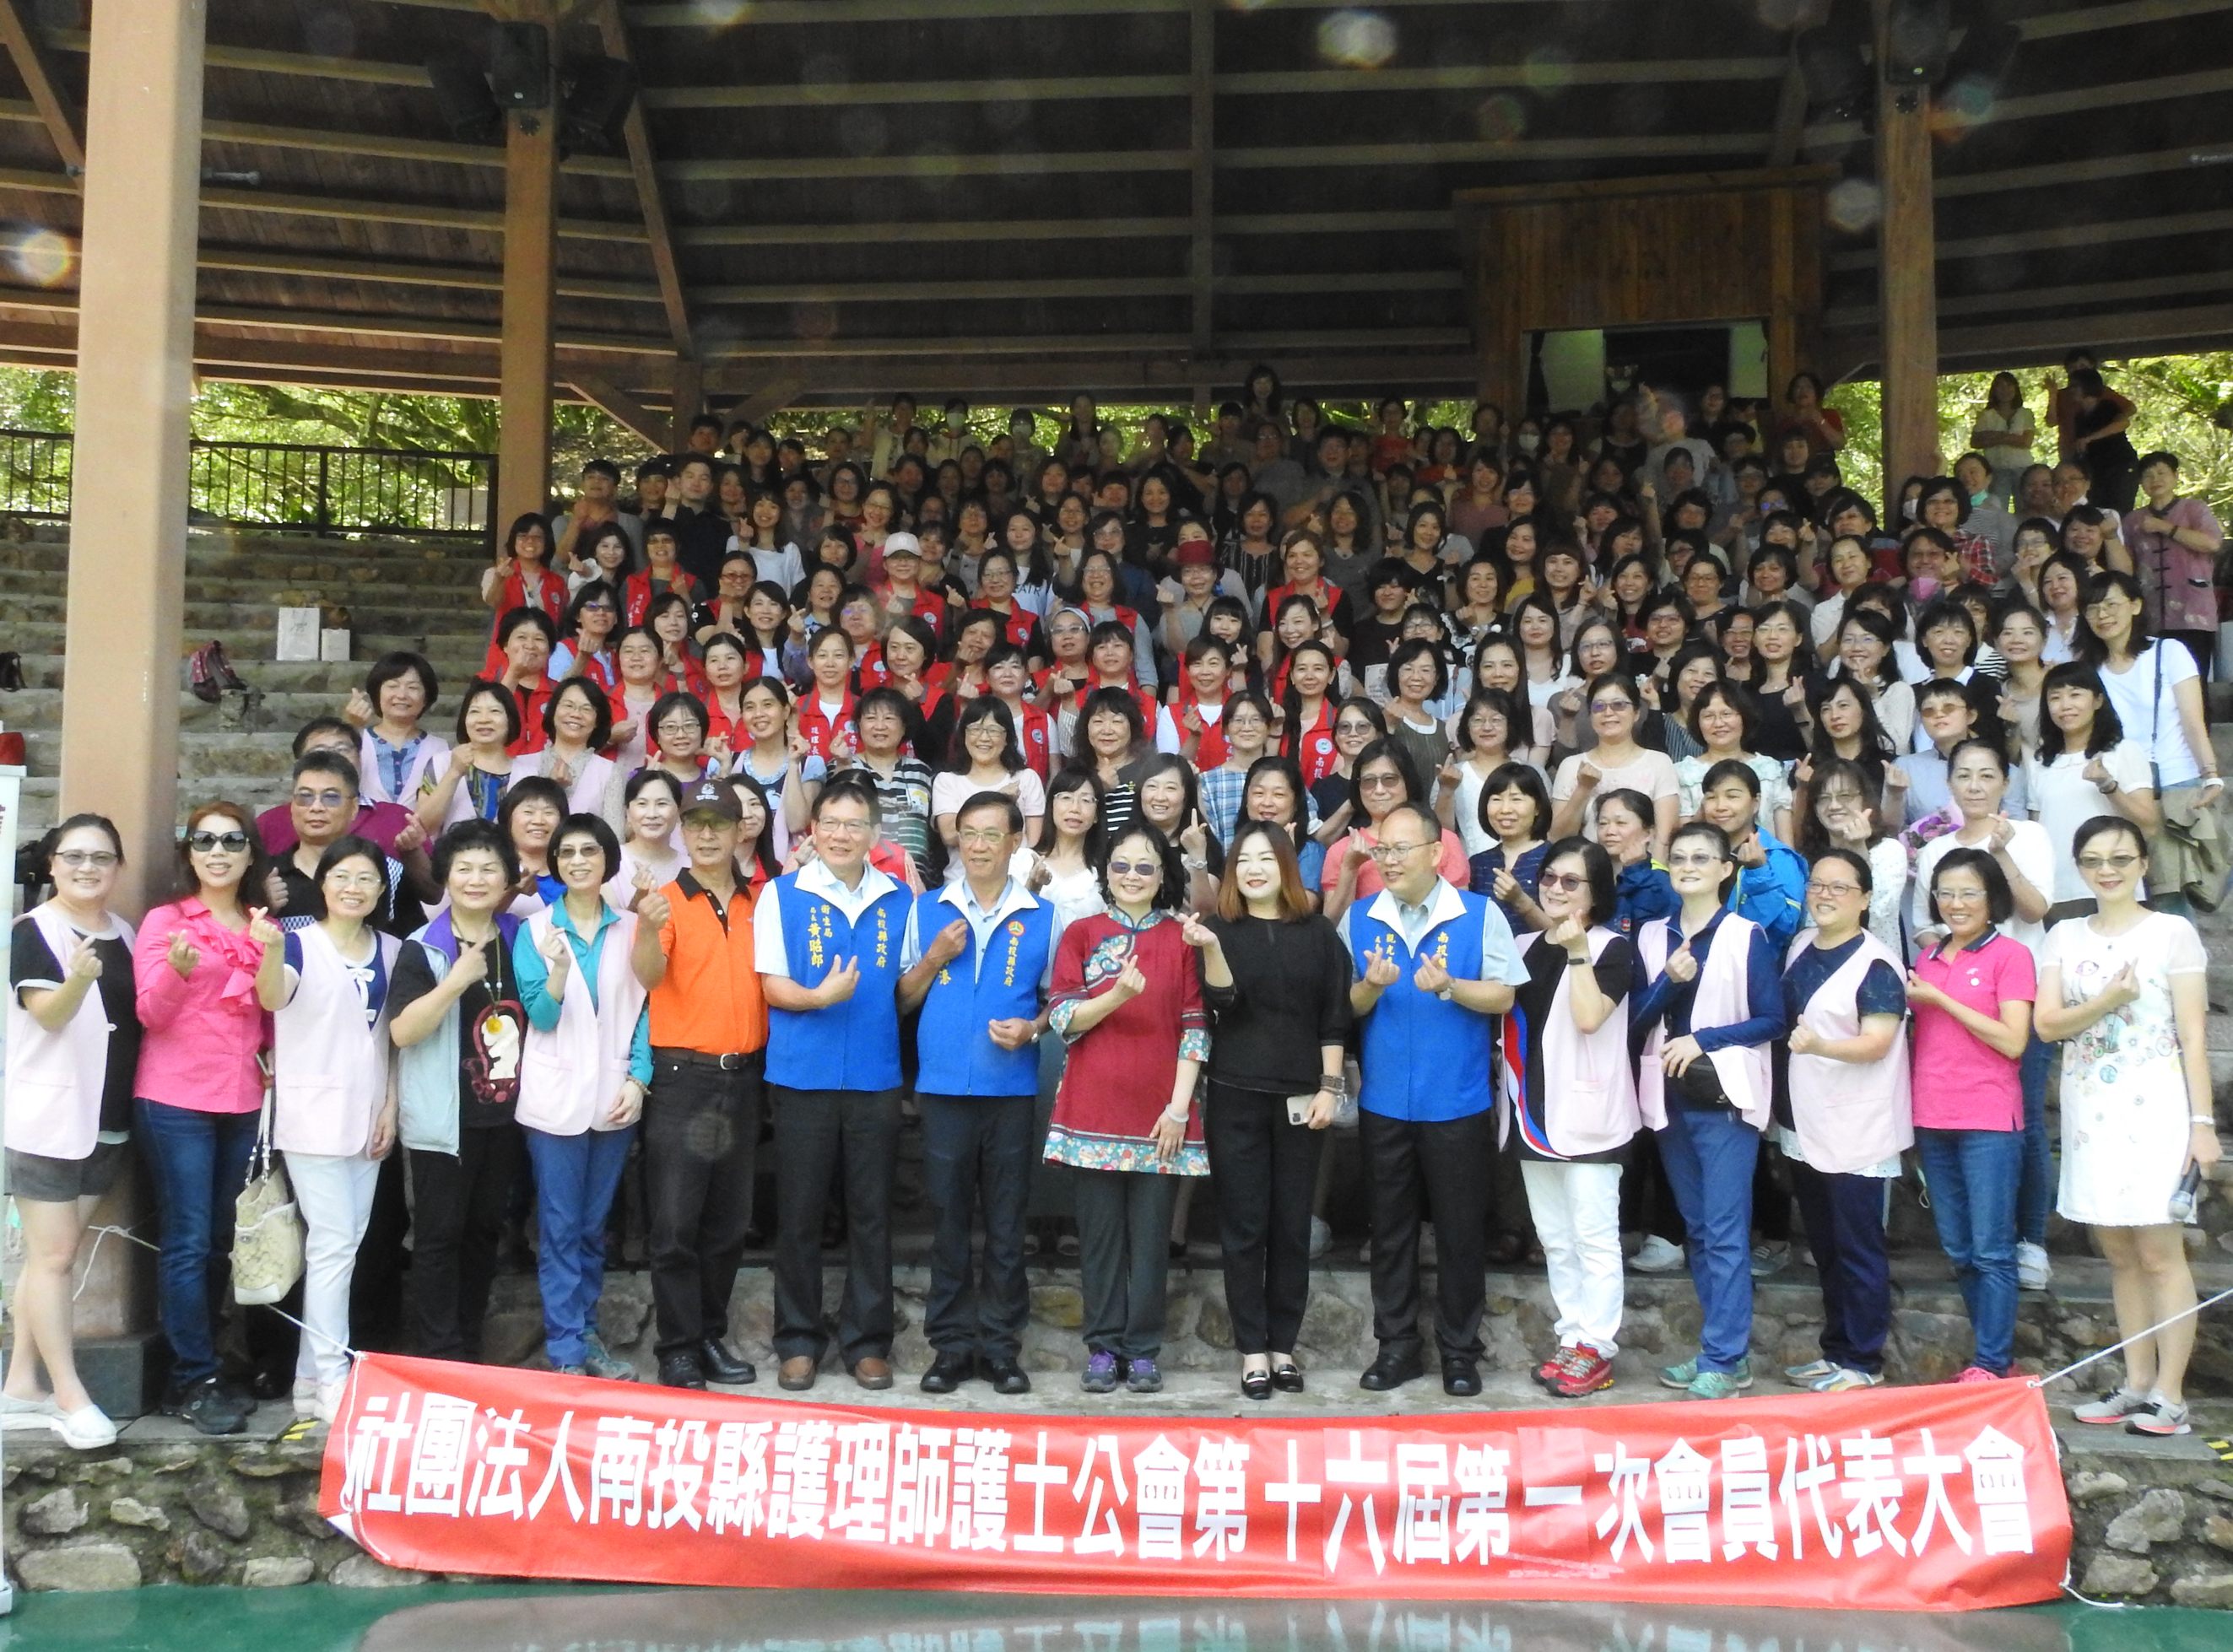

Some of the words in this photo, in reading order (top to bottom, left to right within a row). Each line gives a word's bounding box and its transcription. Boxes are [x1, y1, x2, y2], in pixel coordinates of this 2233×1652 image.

[876, 907, 889, 969] 南投縣政府
[1003, 936, 1019, 987] 南投縣政府
[350, 1391, 2035, 1577] 社團法人南投縣護理師護士公會第十六屆第一次會員代表大會
